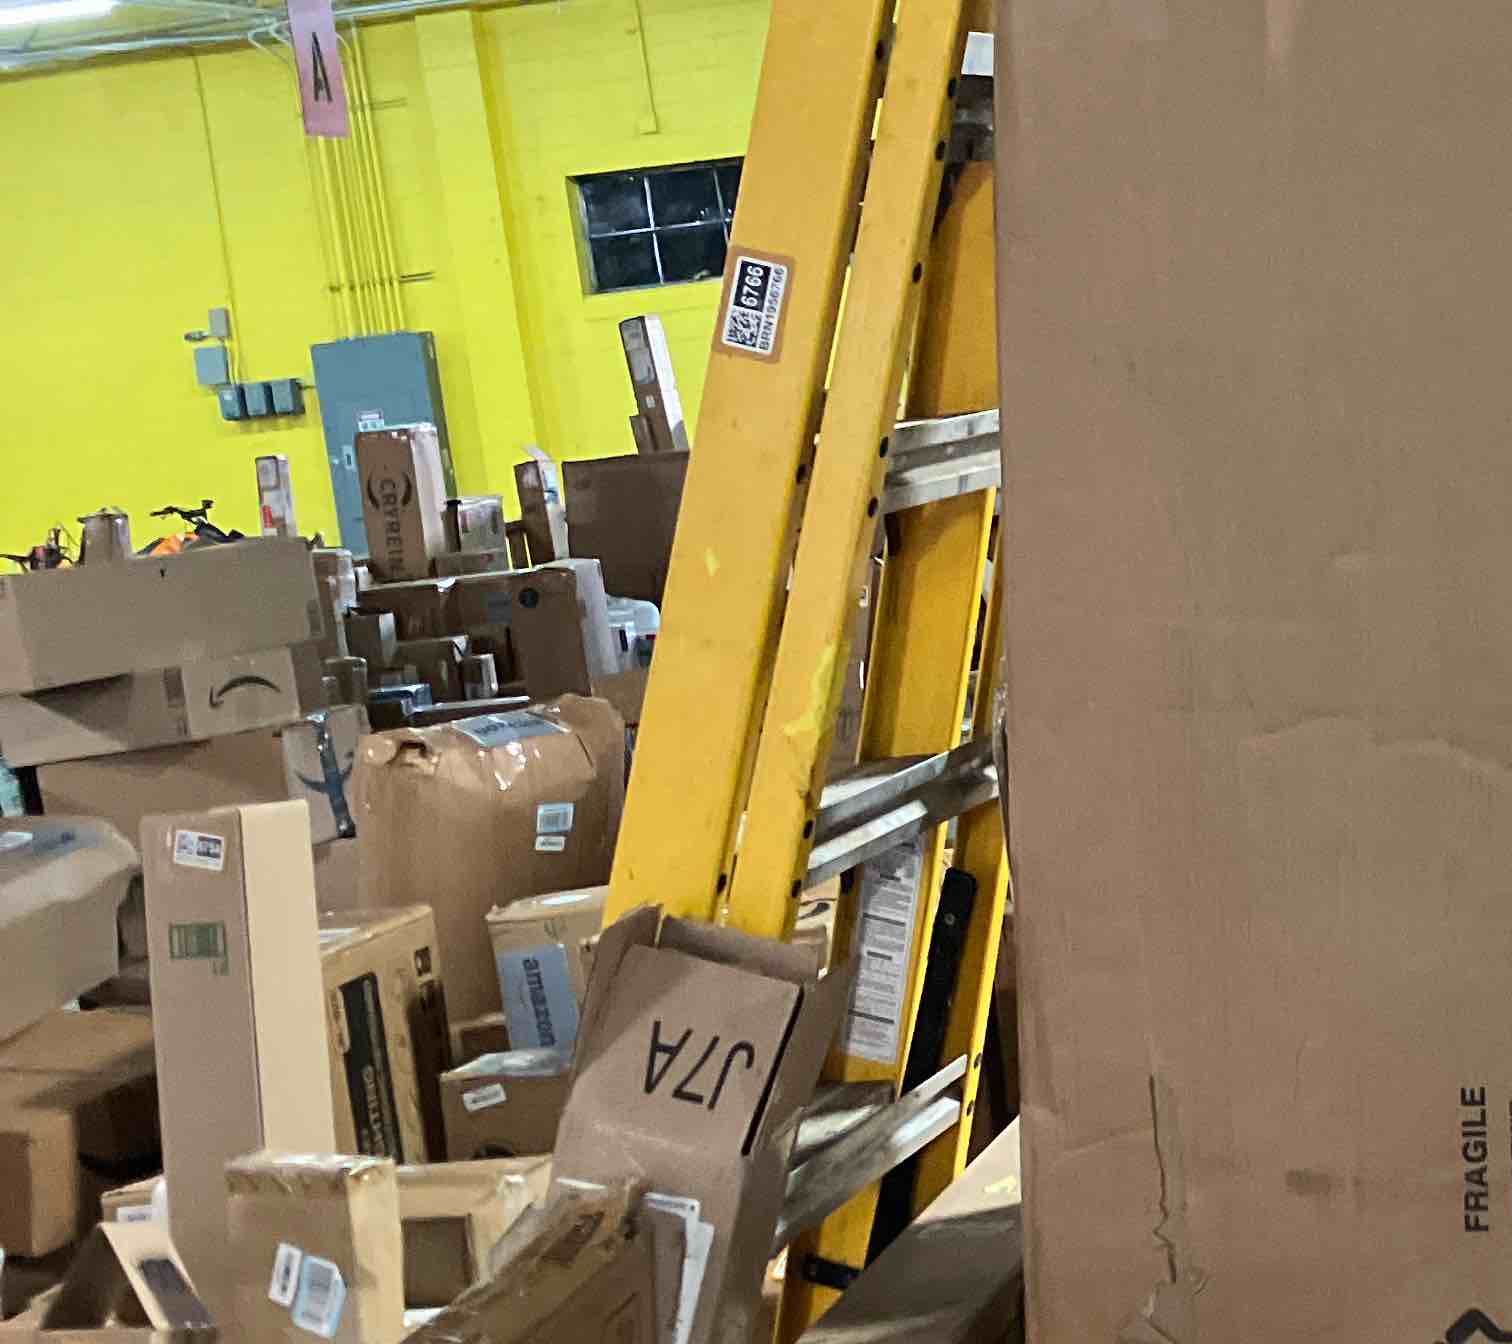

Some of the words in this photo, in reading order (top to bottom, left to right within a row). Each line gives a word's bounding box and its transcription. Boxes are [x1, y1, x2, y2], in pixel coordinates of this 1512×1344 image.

[310, 31, 333, 102] A
[740, 265, 764, 307] 6766
[522, 956, 556, 1047] amazon
[643, 1020, 755, 1110] J7A
[1460, 1086, 1489, 1233] FRAGILE
